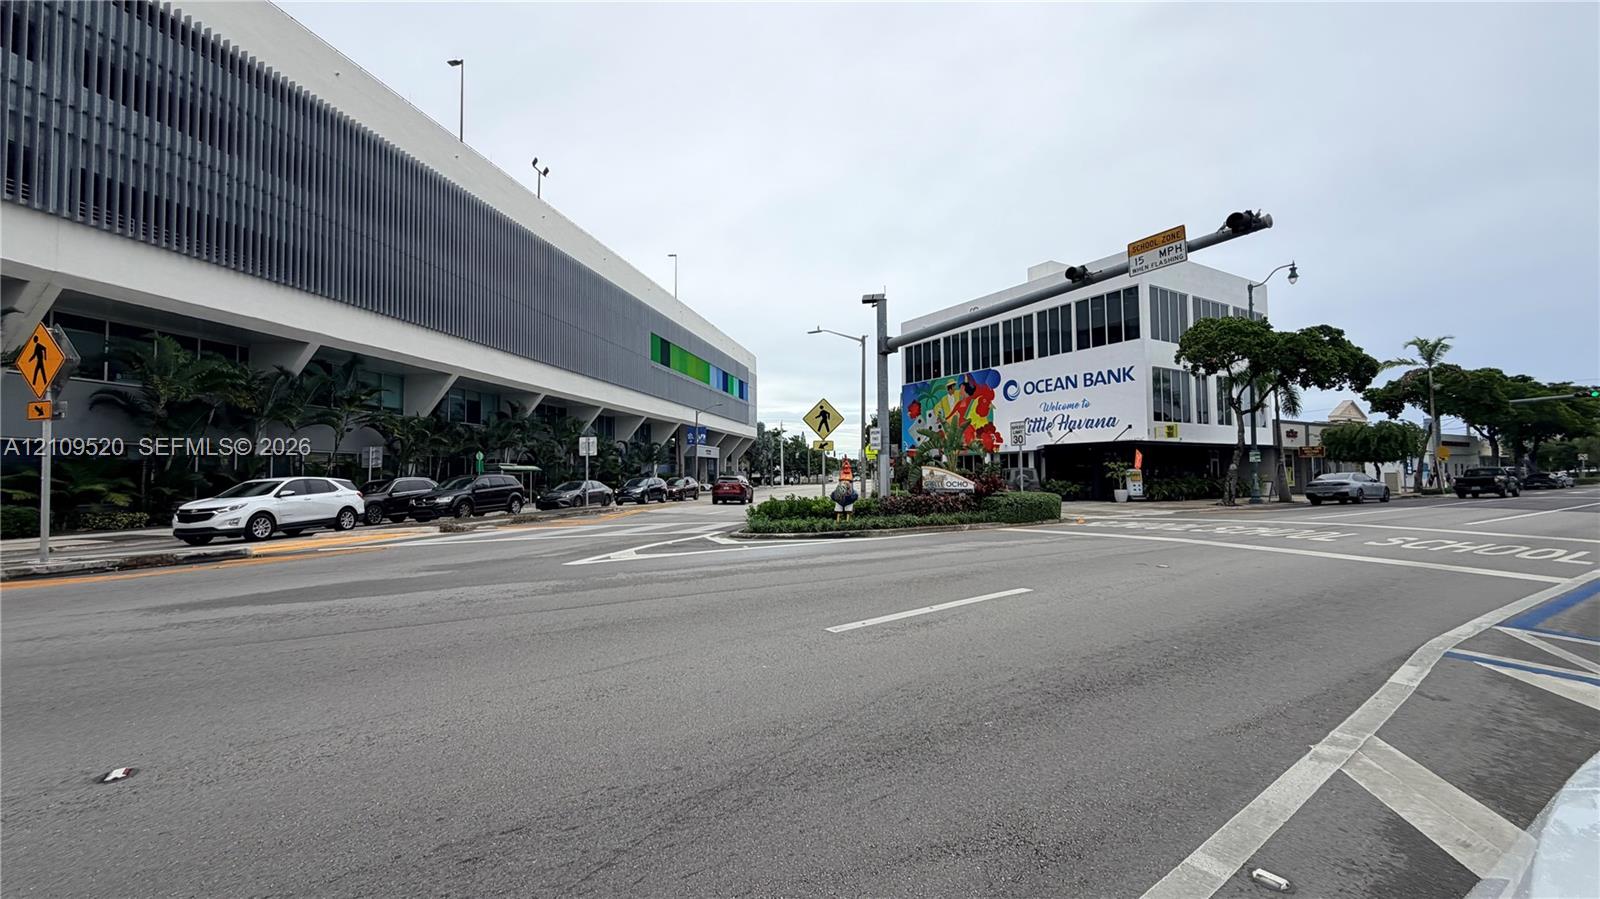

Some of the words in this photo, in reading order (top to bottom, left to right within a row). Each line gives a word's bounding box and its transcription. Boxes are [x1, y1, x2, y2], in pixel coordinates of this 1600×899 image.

[1132, 239, 1159, 253] SCHOOL
[1162, 230, 1181, 243] ZONE
[1132, 264, 1149, 274] WHEN
[1150, 254, 1184, 269] FLASHING
[1134, 255, 1145, 266] 15
[1158, 243, 1182, 258] MPH
[1023, 374, 1078, 396] OCEAN
[1083, 365, 1136, 388] BANK
[1040, 401, 1080, 412] Welcome
[1081, 398, 1090, 408] to
[1053, 413, 1120, 431] Havana
[1013, 435, 1024, 444] 30
[946, 480, 969, 488] OCHO
[1364, 536, 1595, 565] SCHOOL
